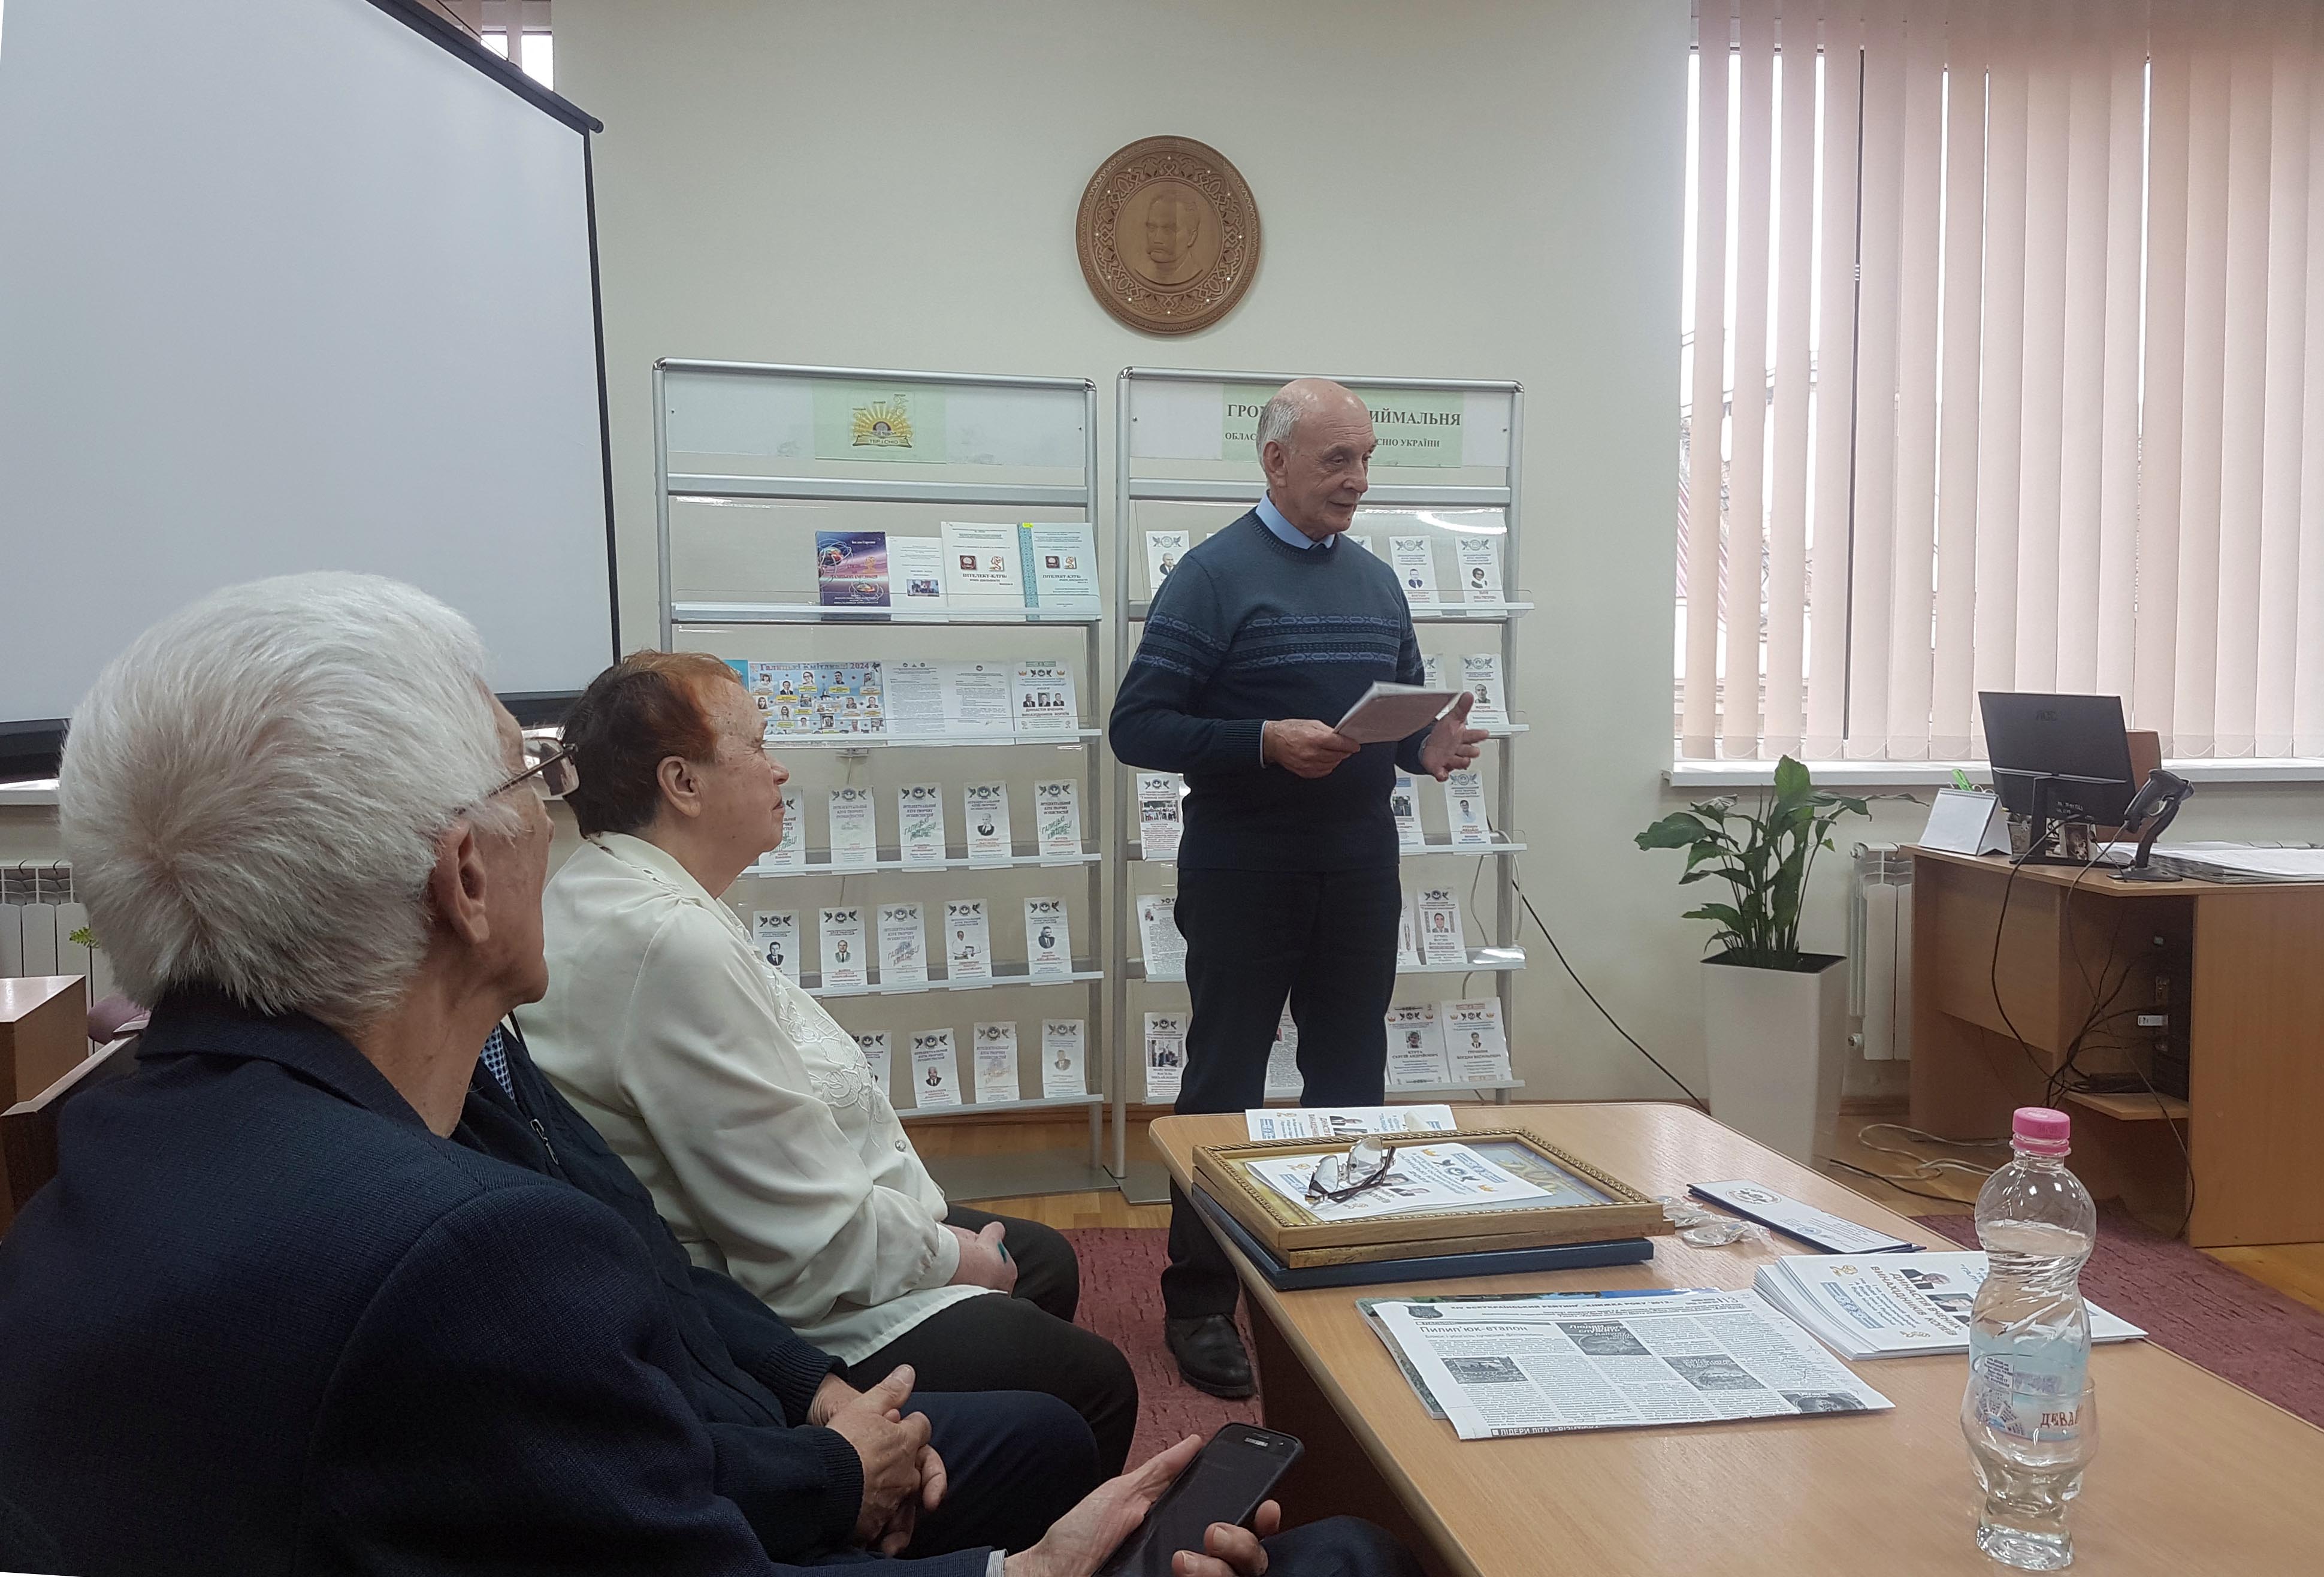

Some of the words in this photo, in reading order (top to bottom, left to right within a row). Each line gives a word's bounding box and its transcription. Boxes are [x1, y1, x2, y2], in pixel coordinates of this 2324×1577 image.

[1227, 404, 1264, 418] ГРО
[1370, 407, 1461, 426] ИЙМАЛЬНЯ
[1225, 432, 1257, 441] ОБЛАС
[1401, 438, 1440, 447] УКРАЇНИ
[1870, 1265, 1927, 1316] ВИНАХІДНИКІВ
[1926, 1318, 1959, 1336] КОПЕЇВ
[1889, 1273, 1930, 1308] ДИНАСТІЯ
[1927, 1306, 1963, 1331] ВЧЕНИХ-
